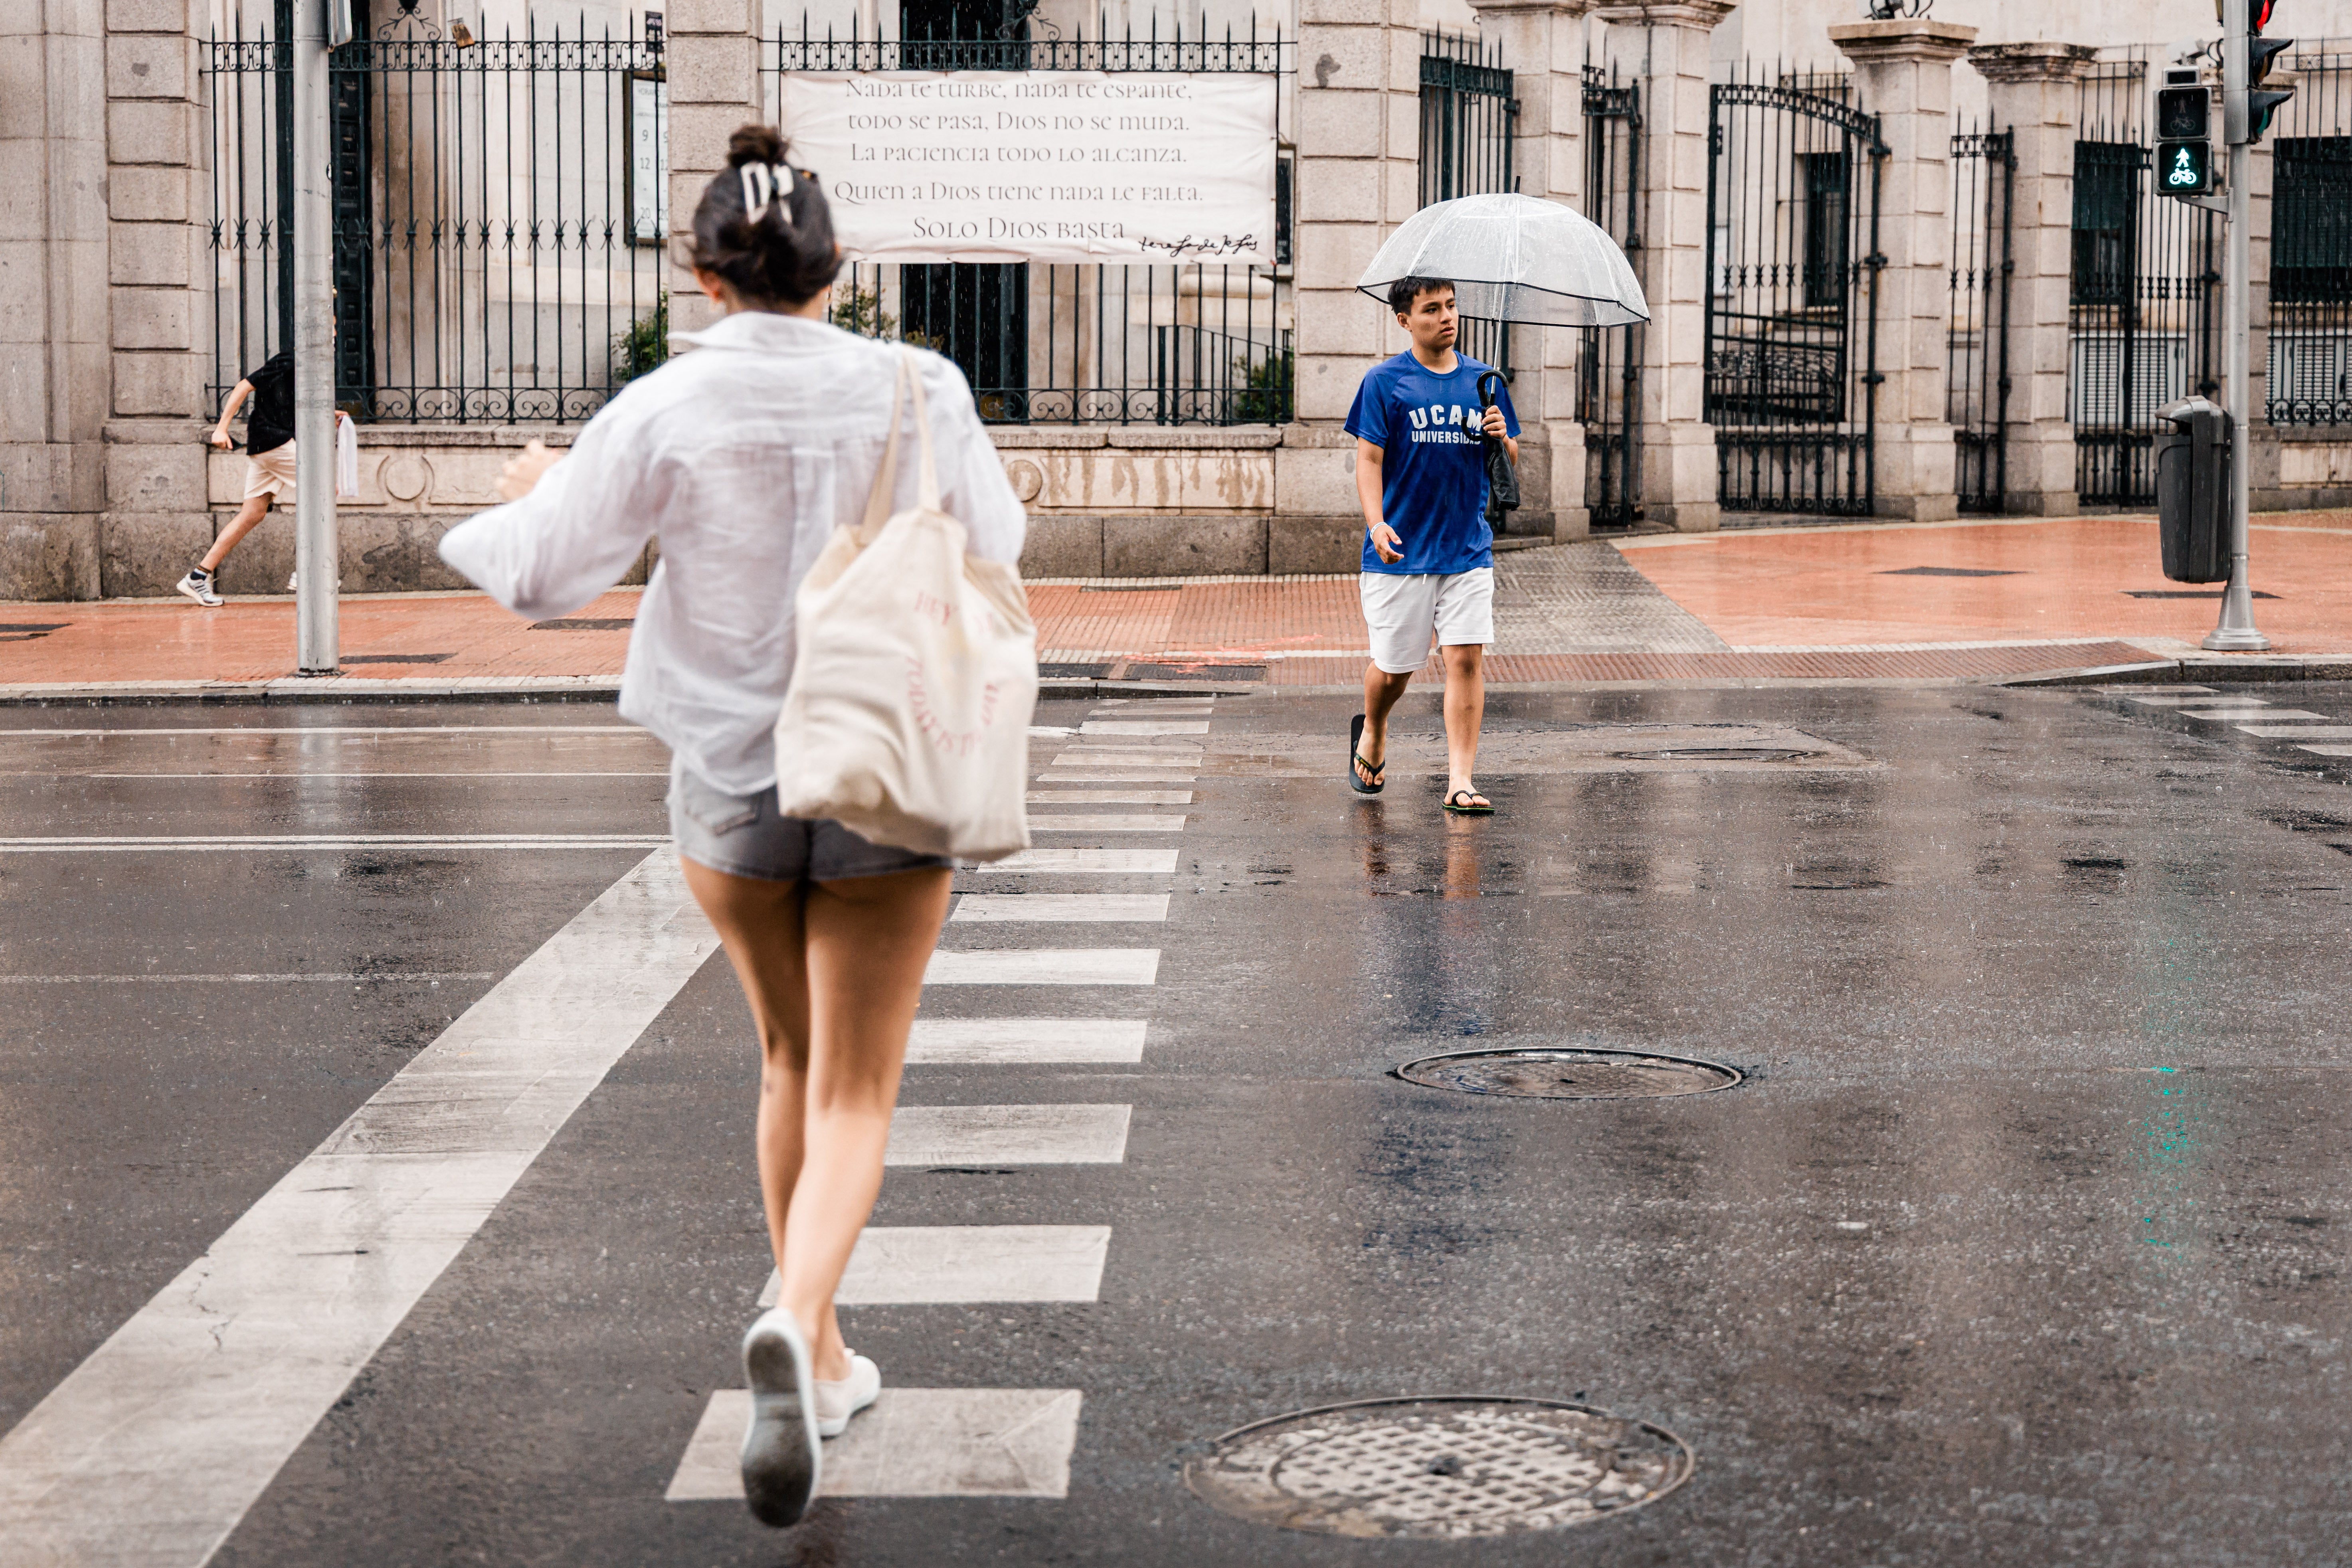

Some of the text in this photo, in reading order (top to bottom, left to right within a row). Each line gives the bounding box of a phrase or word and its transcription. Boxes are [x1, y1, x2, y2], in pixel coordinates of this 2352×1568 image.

[846, 79, 902, 97] Nada
[911, 83, 931, 97] te
[1015, 82, 1068, 98] nada
[1077, 83, 1097, 98] te
[849, 114, 902, 130] todo
[909, 114, 930, 130] se
[997, 111, 1046, 130] Dios
[1054, 115, 1084, 130] no
[1090, 115, 1112, 130] se
[1119, 115, 1189, 131] muda.
[642, 129, 649, 141] 9
[851, 143, 876, 161] La
[884, 146, 989, 161] paciencia
[998, 147, 1051, 162] todo
[1092, 148, 1187, 162] alcanza.
[639, 157, 651, 170] 12
[835, 180, 904, 205] Quien
[912, 186, 922, 200] a
[931, 181, 980, 200] Dios
[988, 185, 1042, 200] tiene
[1050, 186, 1105, 200] nada
[640, 206, 651, 219] 20
[913, 216, 1125, 239] Solo Dios basta
[1408, 404, 1482, 432] UCAM
